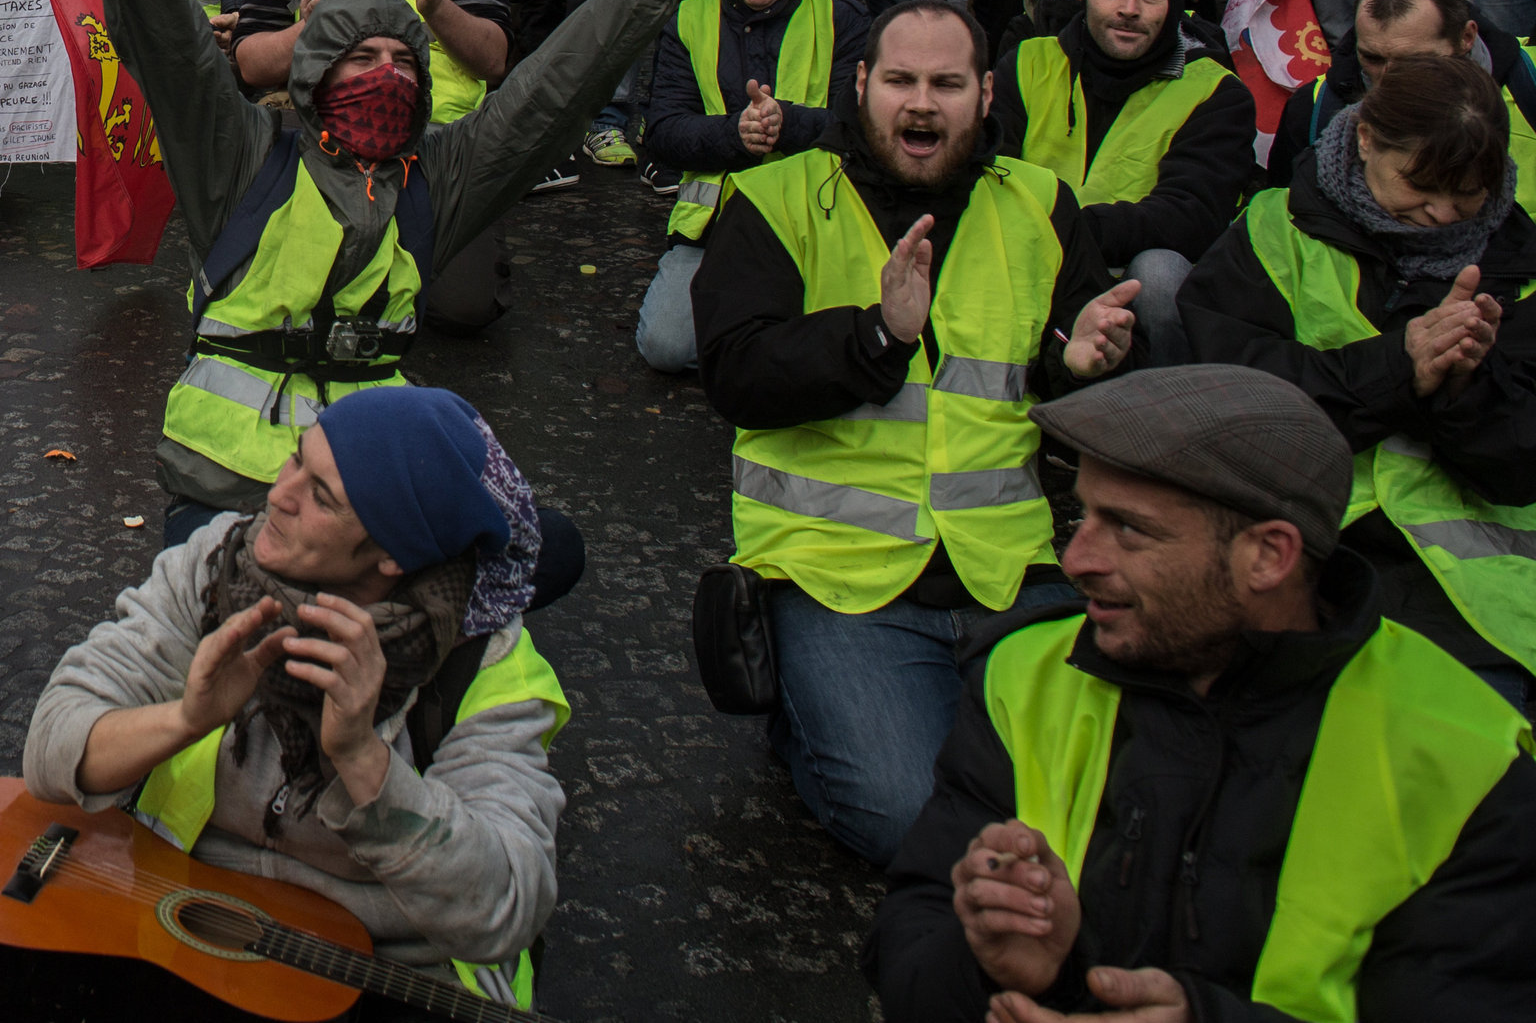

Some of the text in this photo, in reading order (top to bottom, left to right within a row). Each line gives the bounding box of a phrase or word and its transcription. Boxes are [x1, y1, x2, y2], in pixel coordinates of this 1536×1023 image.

[0, 0, 42, 11] TAXES
[18, 81, 48, 89] GAZAGE
[0, 96, 38, 108] PEUPLE
[2, 136, 25, 145] GILET
[30, 133, 56, 143] JAUNE
